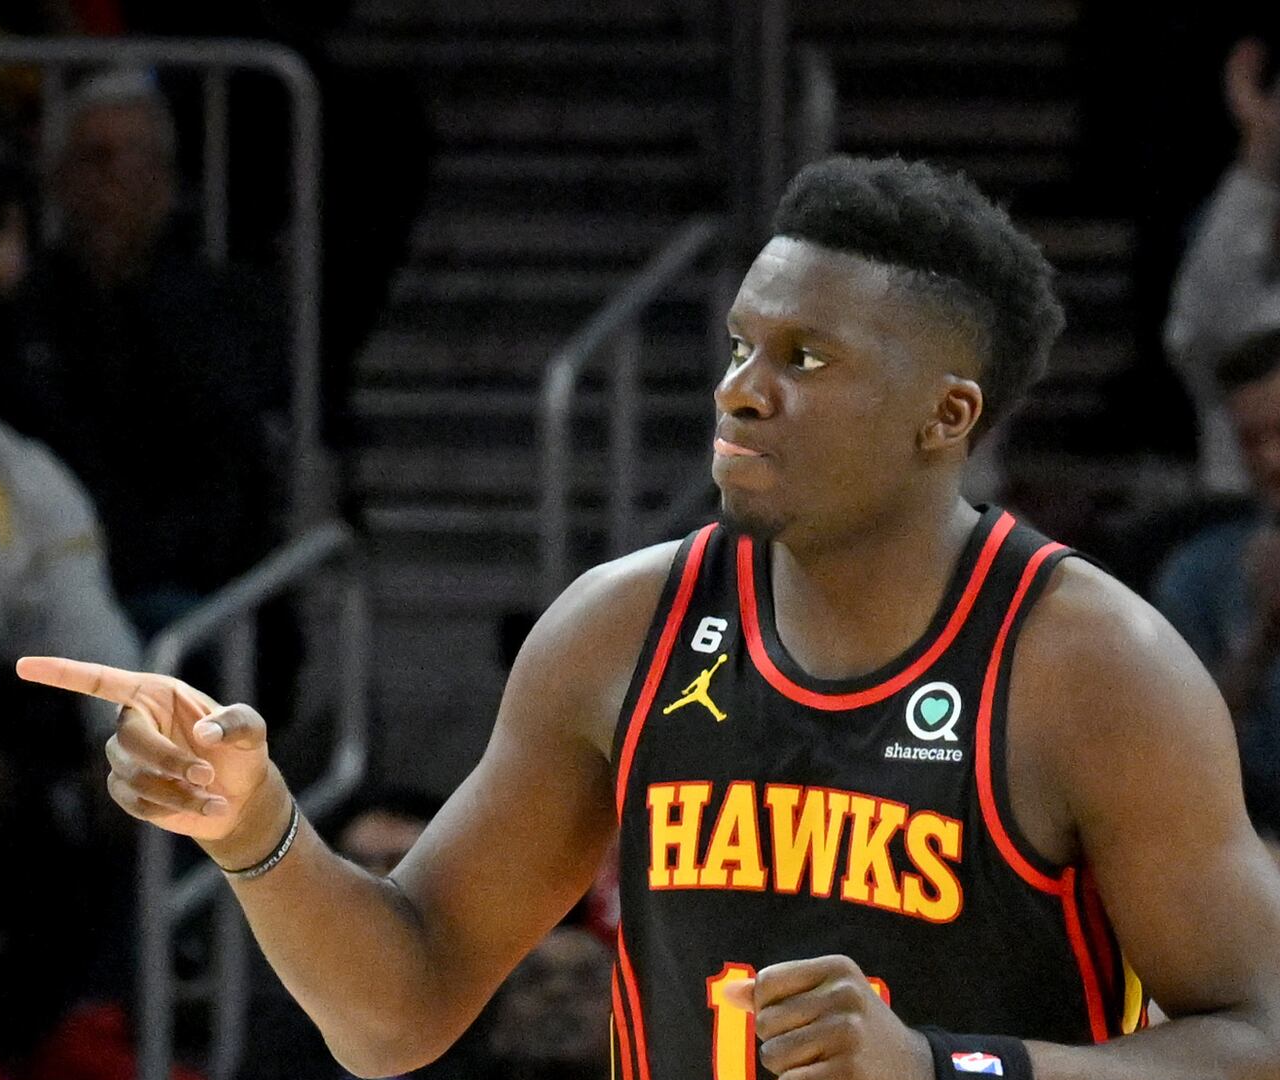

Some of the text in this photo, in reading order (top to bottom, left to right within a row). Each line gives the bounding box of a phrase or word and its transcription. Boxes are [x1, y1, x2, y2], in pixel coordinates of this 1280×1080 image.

[691, 616, 728, 654] 6
[884, 742, 963, 762] sharecare
[647, 780, 964, 924] HAWKS
